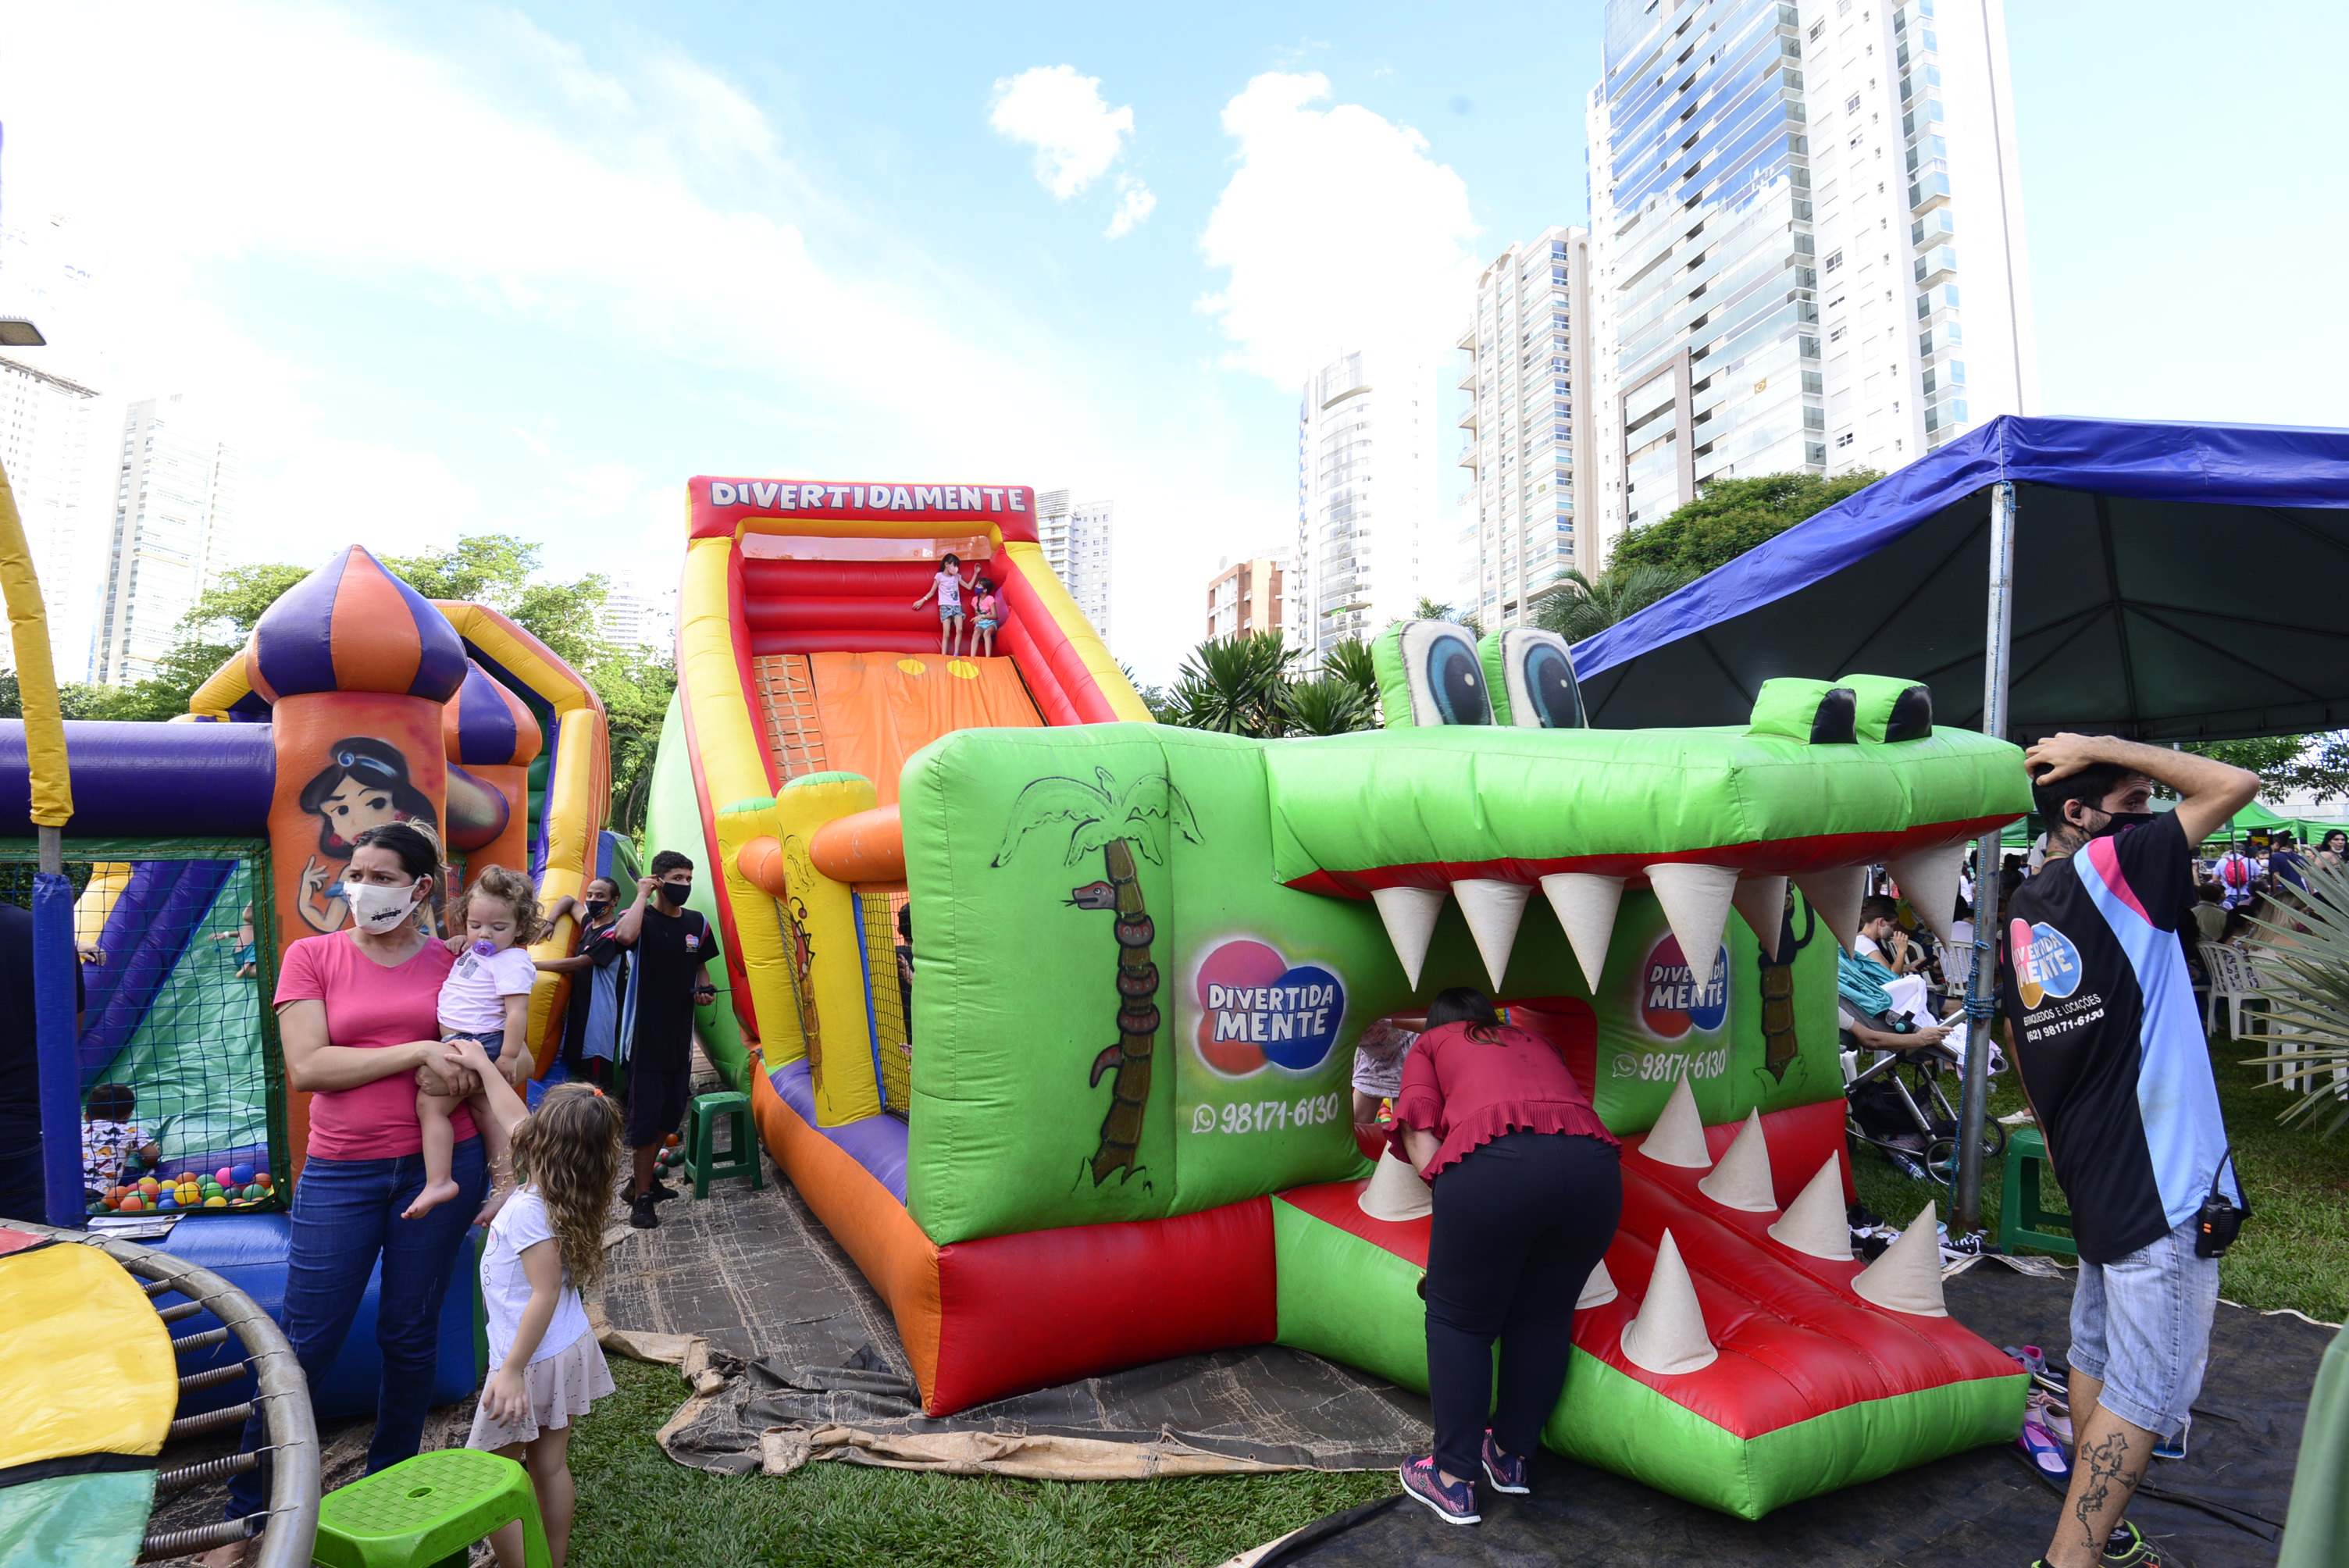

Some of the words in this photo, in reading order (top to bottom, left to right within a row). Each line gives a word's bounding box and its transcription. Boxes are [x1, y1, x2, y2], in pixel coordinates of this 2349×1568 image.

[710, 481, 1026, 512] DIVERTIDAMENTE
[1649, 961, 1724, 983] DIVEIDA
[2018, 948, 2074, 988] MENTE
[1208, 983, 1334, 1011] DIVERTIDA
[1649, 981, 1723, 1010] MENTE
[1215, 1007, 1329, 1042] MENTE
[2057, 1007, 2062, 1017] E
[2026, 1028, 2041, 1042] (62)
[1640, 1049, 1726, 1082] 98171-6130
[1220, 1092, 1339, 1134] 98171-6130
